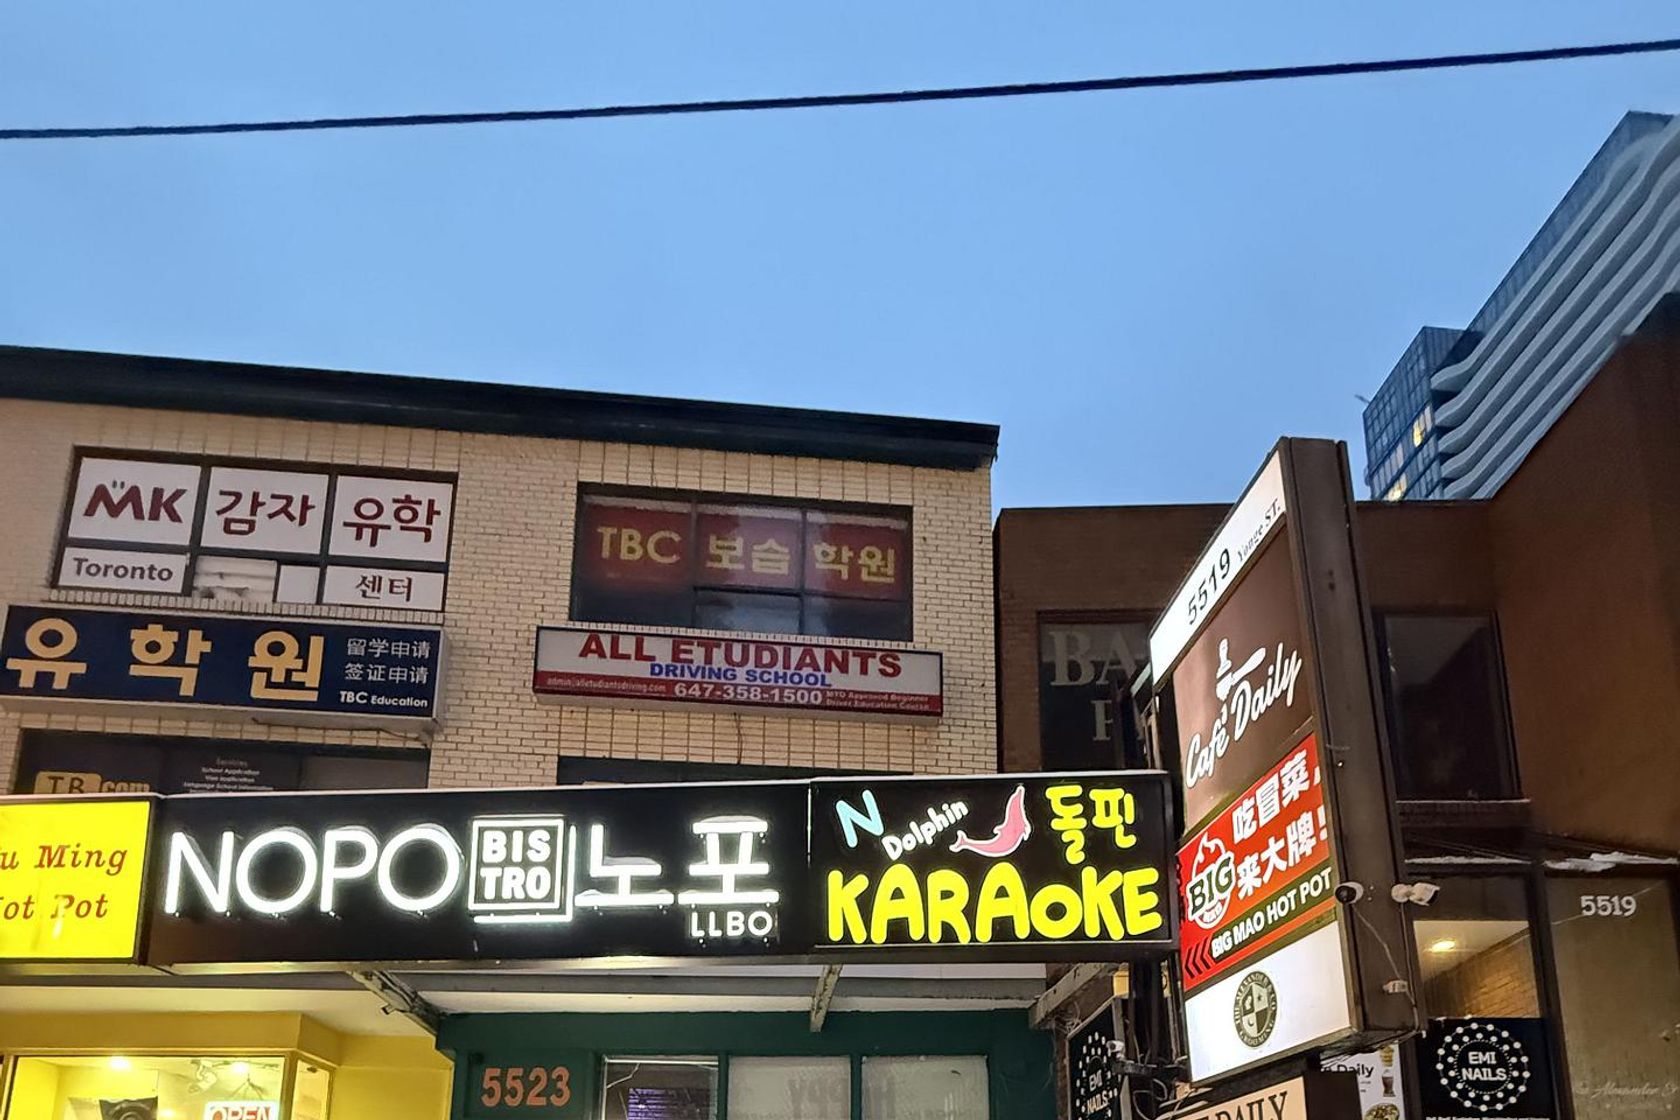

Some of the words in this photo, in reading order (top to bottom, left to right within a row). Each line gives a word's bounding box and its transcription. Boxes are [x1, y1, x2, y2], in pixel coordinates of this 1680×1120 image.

[84, 480, 188, 523] MK
[216, 490, 315, 536] 감자
[344, 495, 442, 547] 유학
[597, 527, 681, 564] TBC
[706, 536, 790, 575] 보습
[814, 544, 895, 583] 학원
[73, 557, 173, 582] Toronto
[1187, 549, 1231, 625] 5519
[355, 574, 413, 603] 센터
[347, 638, 431, 659] 留学申请
[579, 634, 655, 662] ALL
[672, 639, 902, 678] ETUDIANTS
[345, 663, 428, 684] 签证申请
[650, 662, 738, 684] DRIVING
[745, 668, 832, 688] SCHOOL
[1231, 642, 1302, 741] Daily
[340, 691, 369, 704] TBC
[371, 696, 429, 708] Education
[675, 682, 823, 706] 647-358-1500
[835, 789, 884, 849] N
[882, 800, 969, 861] Dolphin
[1046, 784, 1137, 865] 돌핀
[35, 843, 128, 876] Ming
[482, 829, 551, 864] BIS
[575, 820, 780, 907] 노포
[165, 824, 463, 915] NOPO
[480, 866, 551, 900] TRO
[1189, 856, 1233, 916] BIG
[51, 893, 108, 920] Pot
[827, 862, 1163, 944] KARAOKE
[1211, 929, 1231, 959] BIG
[1232, 913, 1264, 947] MAO
[1265, 888, 1297, 924] HOT
[1300, 868, 1332, 905] POT
[1580, 895, 1637, 917] 5519
[690, 910, 773, 937] LLBO
[1461, 1068, 1507, 1081] NAILS
[1468, 1051, 1497, 1065] EMI
[481, 1066, 571, 1108] 5523
